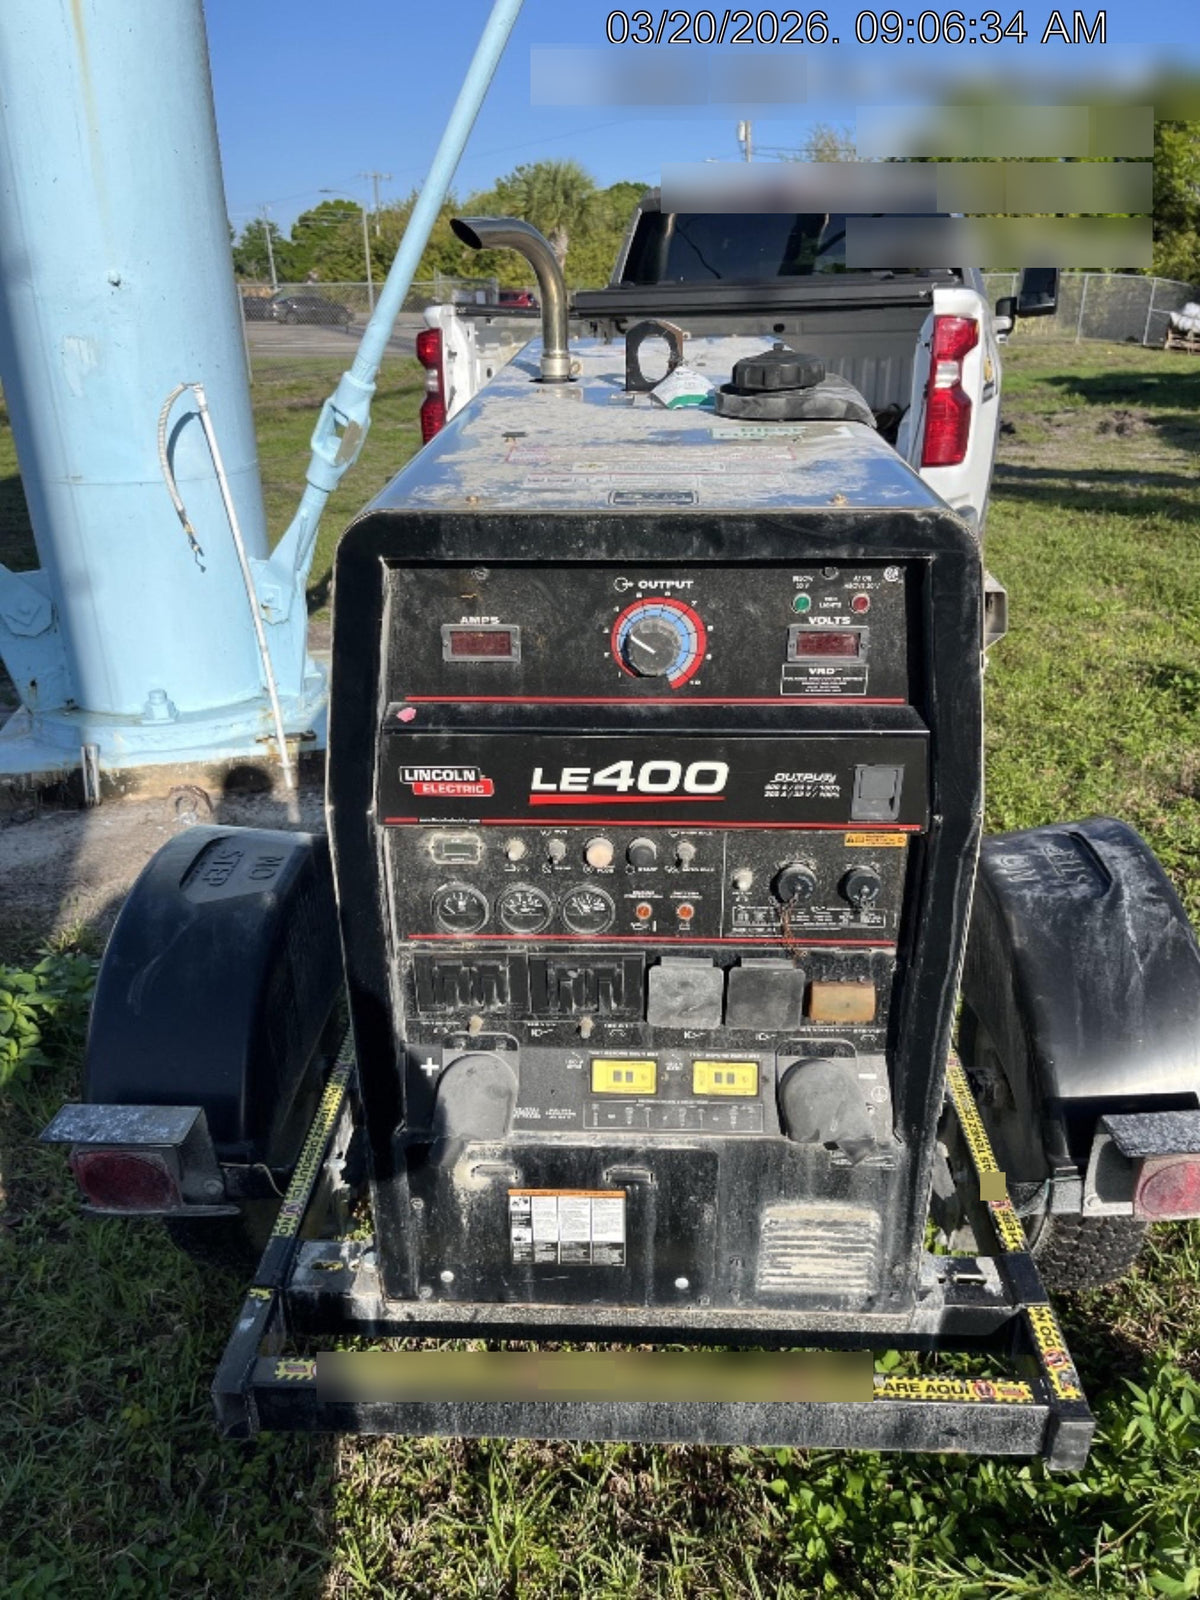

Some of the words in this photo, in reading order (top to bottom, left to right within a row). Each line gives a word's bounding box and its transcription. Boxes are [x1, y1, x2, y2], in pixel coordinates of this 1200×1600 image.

[638, 580, 694, 589] OUTPUT
[460, 616, 501, 625] AMPS
[808, 616, 851, 625] VOLTS
[404, 769, 476, 781] LINCOLN
[530, 760, 730, 794] LE400
[422, 784, 485, 794] ELECTRIC
[279, 1218, 291, 1233] NO
[874, 1382, 921, 1393] ARE
